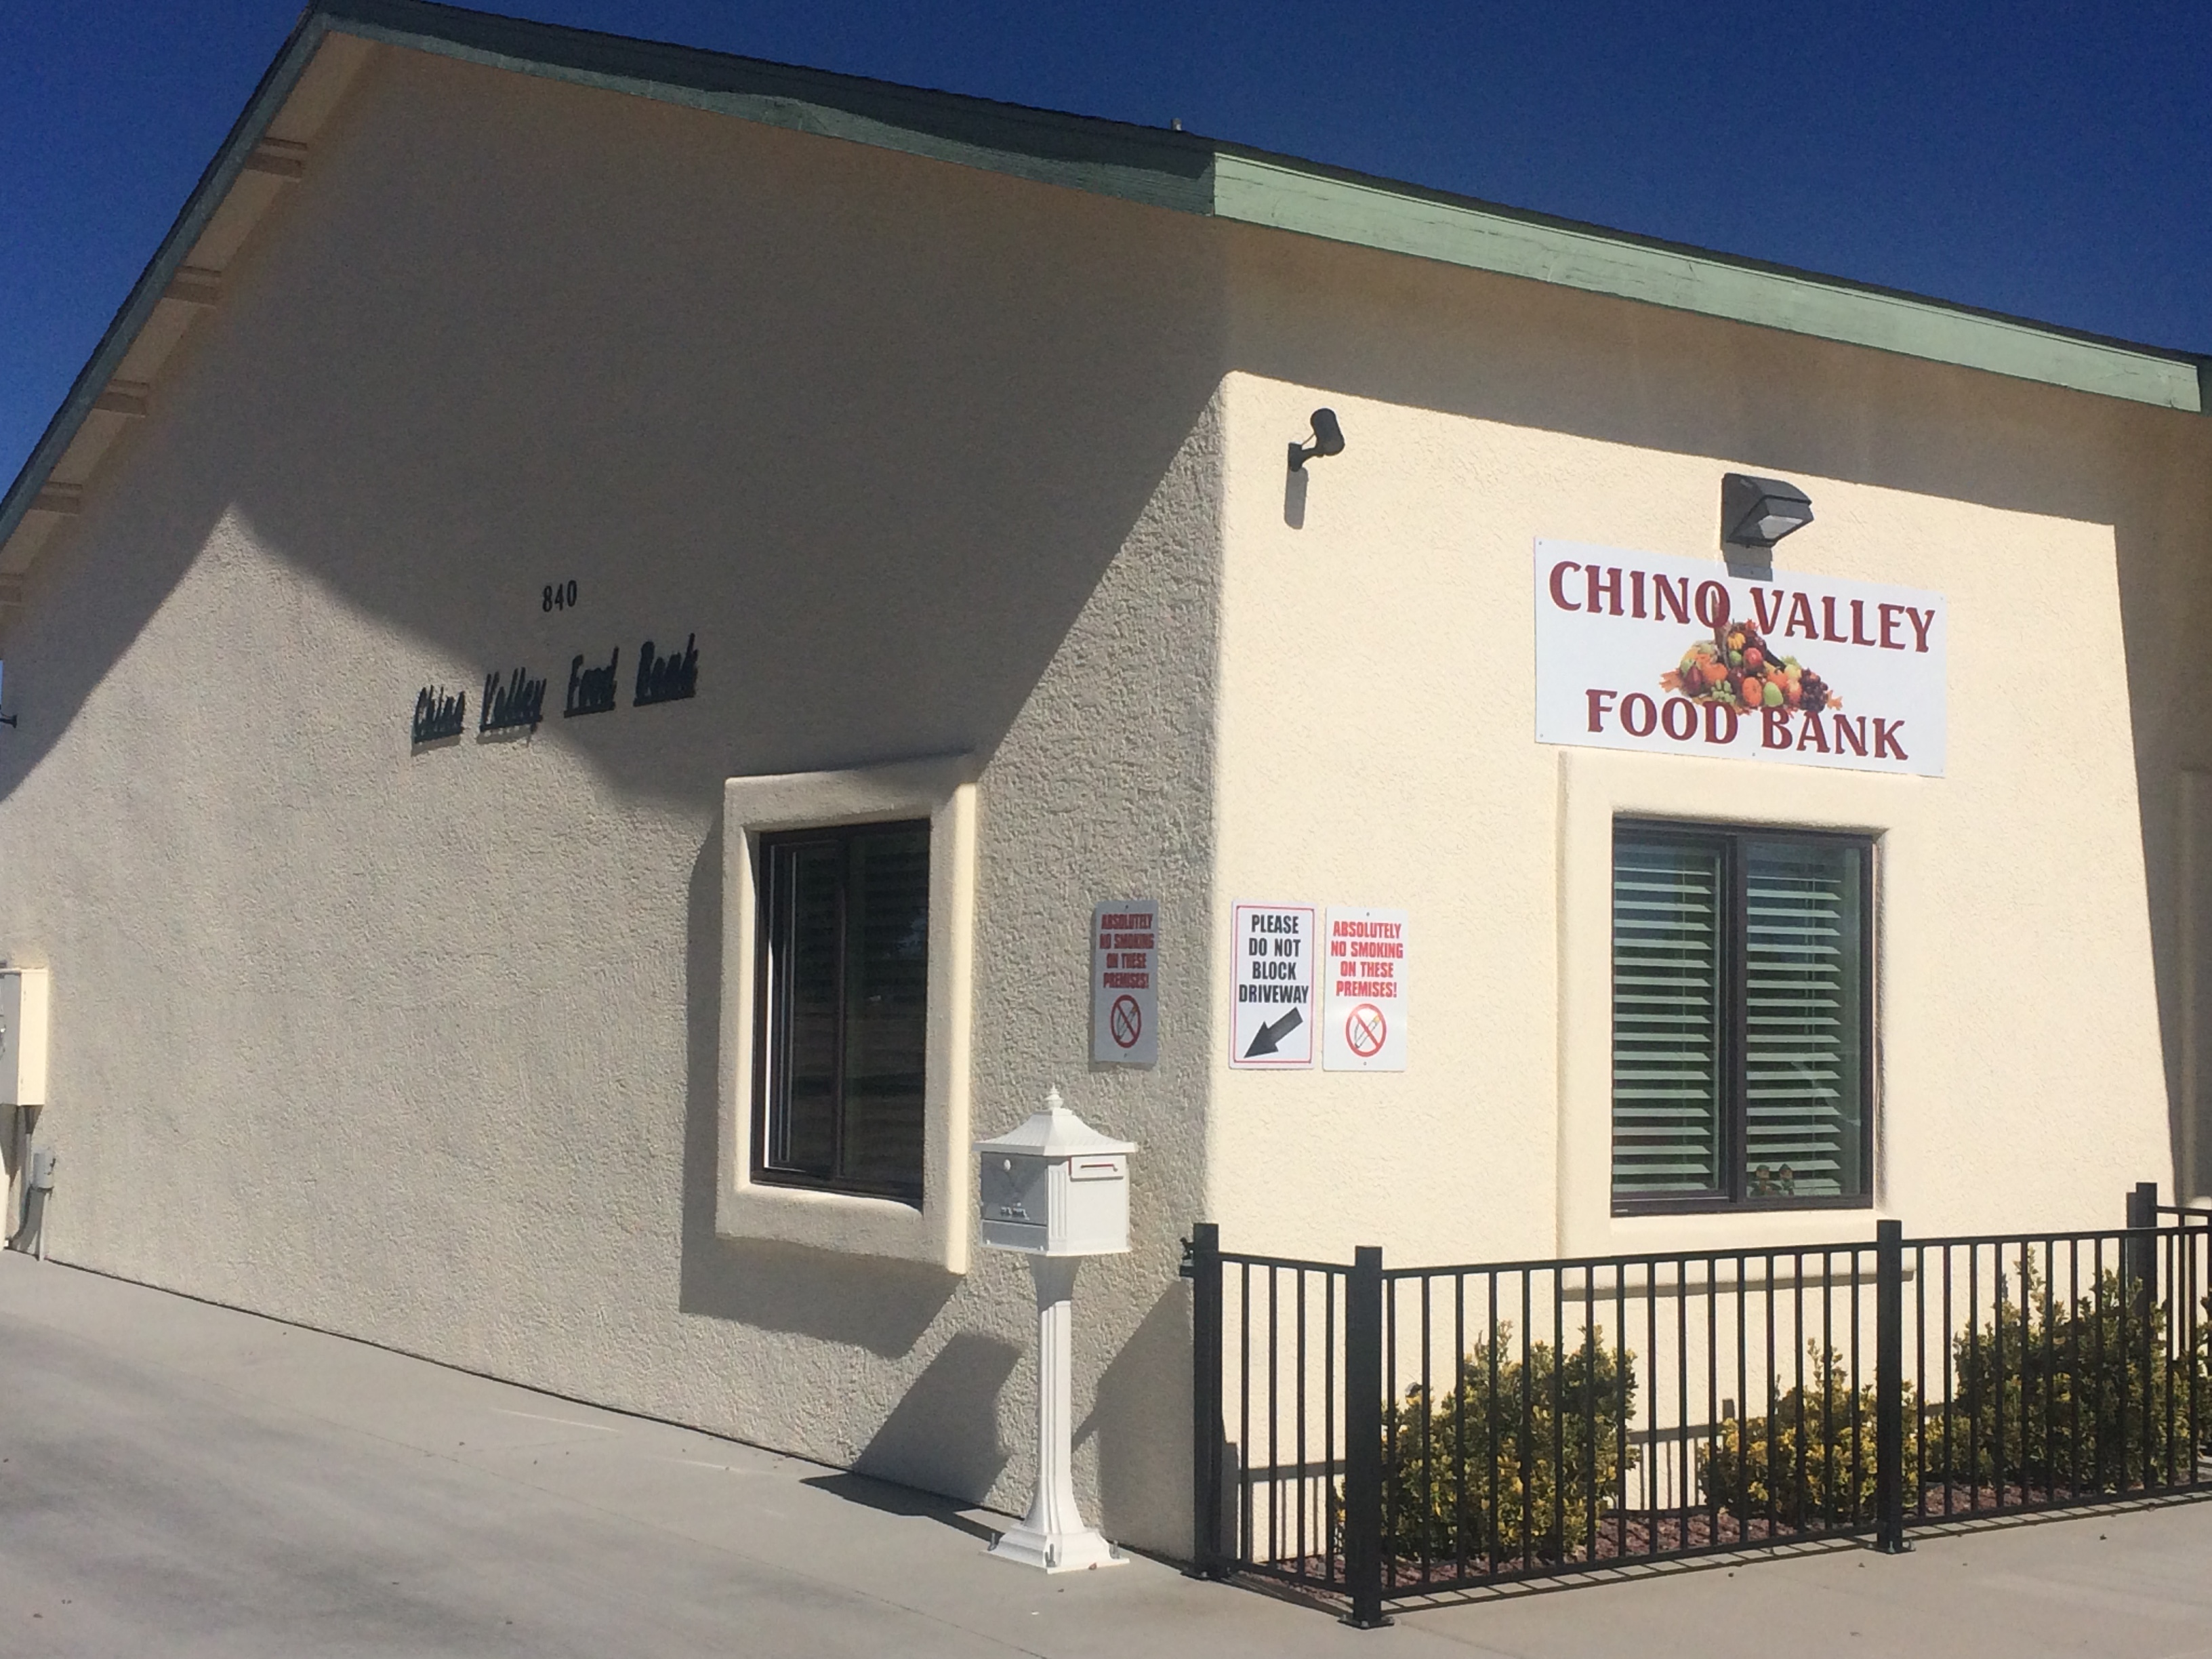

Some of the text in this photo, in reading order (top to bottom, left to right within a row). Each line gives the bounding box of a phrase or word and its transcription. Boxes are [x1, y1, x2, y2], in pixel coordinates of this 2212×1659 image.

[541, 580, 577, 613] 840
[1549, 561, 1936, 653] CHINO VALLEY
[1585, 689, 1908, 760] FOOD BANK
[1101, 913, 1153, 930] ABSOLUTELY
[1251, 914, 1299, 934] PLEASE
[1332, 920, 1401, 939] ABSOLUTELY
[1099, 933, 1155, 950] NO SMOKING
[1248, 938, 1301, 957] DO NOT
[1330, 941, 1404, 959] NO SMOKING
[1106, 953, 1147, 969] ON THESE
[1340, 961, 1394, 979] ON THESE
[1102, 972, 1150, 989] PREMISES!
[1252, 962, 1296, 981] BLOCK
[1238, 985, 1309, 1004] DRIVEWAY
[1336, 981, 1397, 998] PREMISES!
